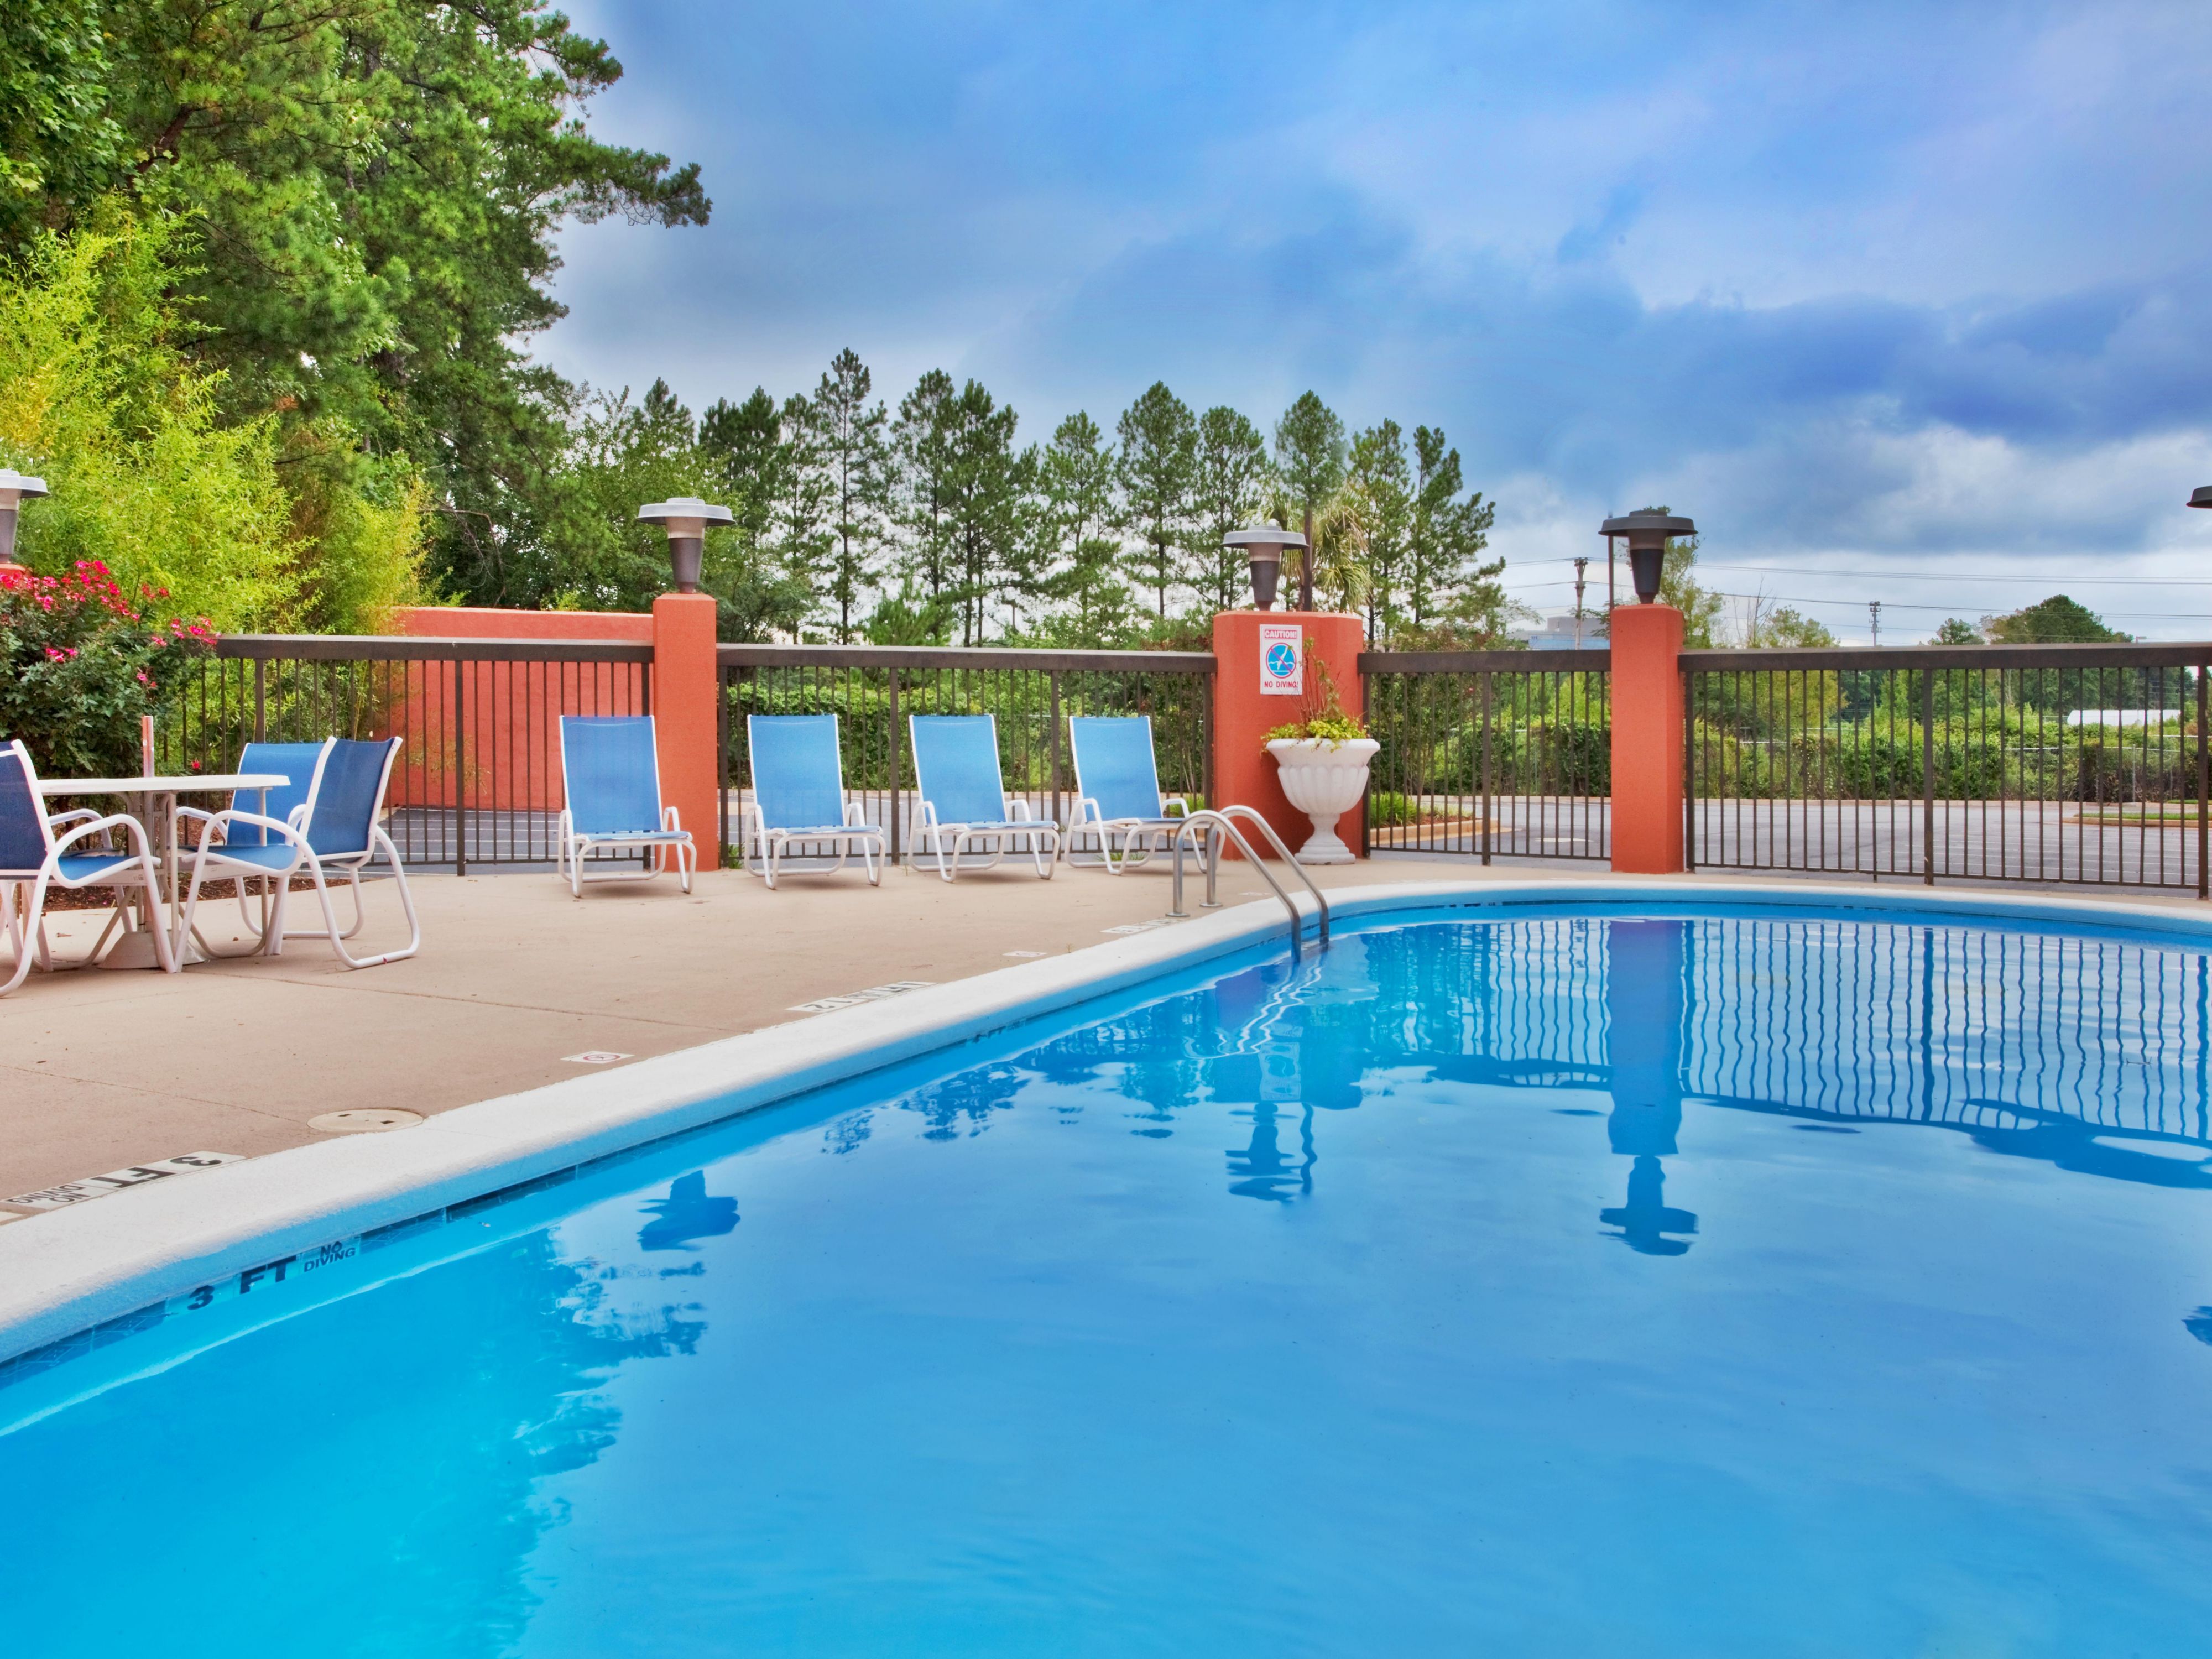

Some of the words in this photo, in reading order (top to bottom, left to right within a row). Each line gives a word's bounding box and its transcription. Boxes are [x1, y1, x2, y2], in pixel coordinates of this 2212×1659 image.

[1265, 630, 1297, 638] CAUTION!
[169, 1156, 222, 1166] 3
[90, 1167, 177, 1188] FT
[4, 1185, 85, 1203] DIVING
[48, 1193, 90, 1203] NO
[320, 1241, 343, 1258] NO
[304, 1247, 356, 1272] DIVING
[186, 1285, 215, 1311] 3
[239, 1255, 297, 1295] FT
